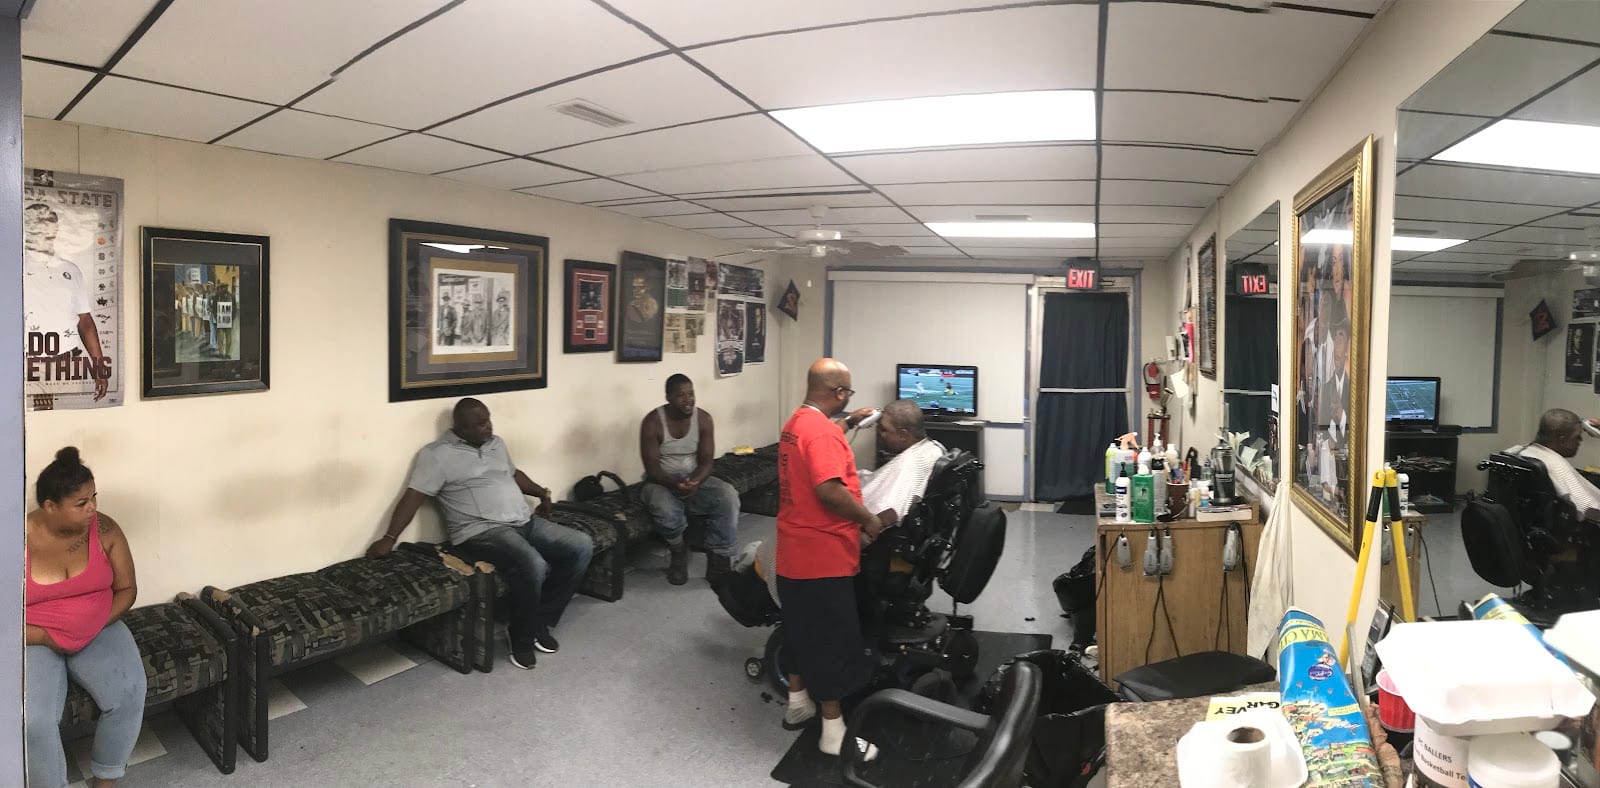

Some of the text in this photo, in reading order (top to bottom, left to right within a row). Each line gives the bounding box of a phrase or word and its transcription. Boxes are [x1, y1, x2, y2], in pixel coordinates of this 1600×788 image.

[57, 190, 112, 208] STATE
[1068, 269, 1095, 289] EXIT
[222, 304, 231, 315] AM
[28, 331, 60, 356] DO
[27, 356, 112, 382] ETHING
[1214, 701, 1280, 715] GARVEY
[1424, 743, 1452, 763] BALLERS
[1420, 754, 1454, 778] Basketball
